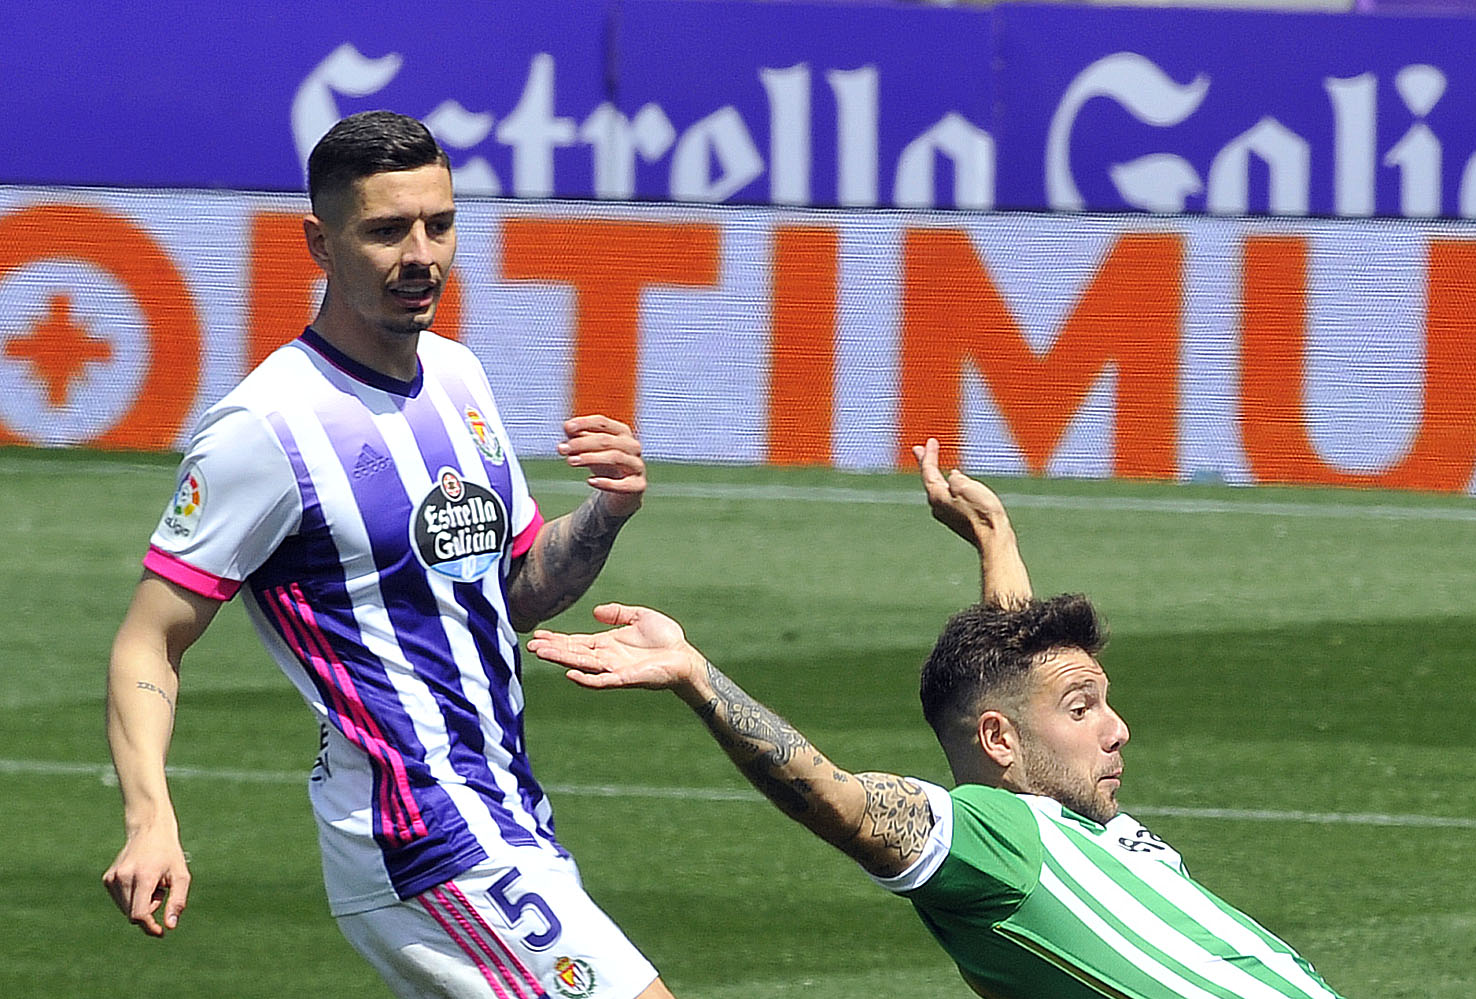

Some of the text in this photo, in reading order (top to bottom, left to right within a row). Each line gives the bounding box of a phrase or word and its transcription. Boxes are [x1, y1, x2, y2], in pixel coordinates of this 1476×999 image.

[424, 496, 498, 534] Estrella
[435, 524, 497, 560] Galicia
[486, 866, 563, 953] 5
